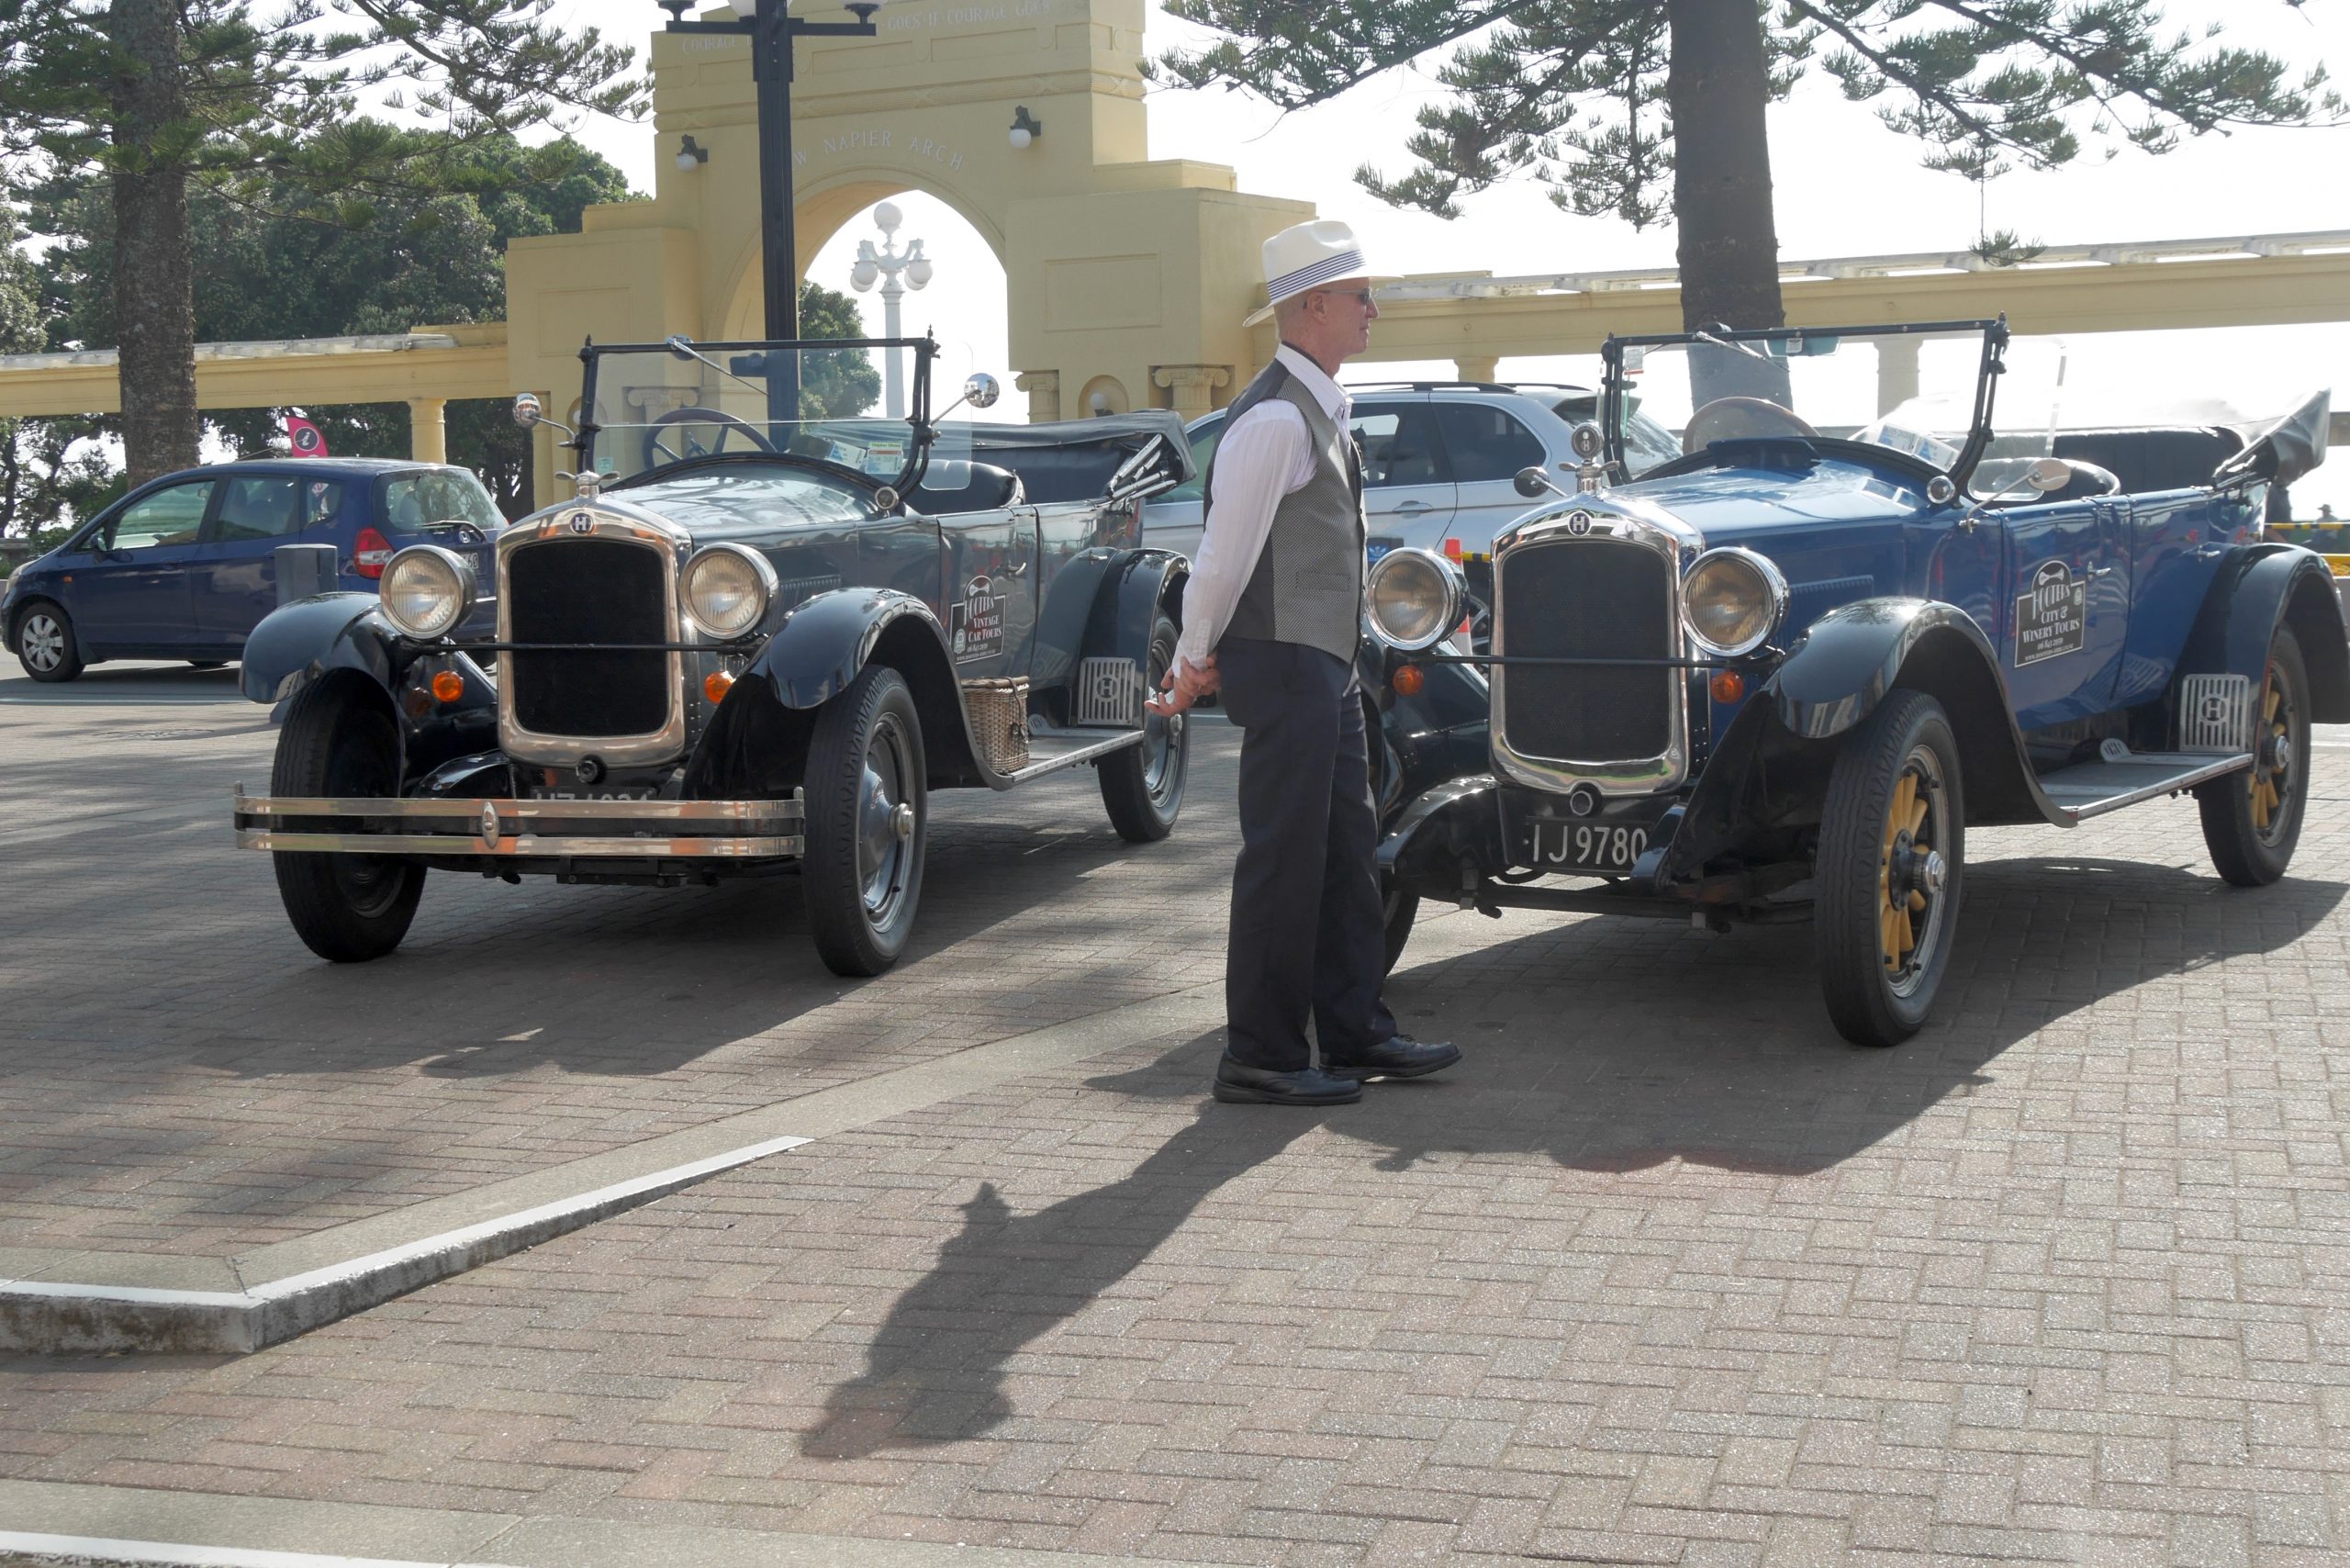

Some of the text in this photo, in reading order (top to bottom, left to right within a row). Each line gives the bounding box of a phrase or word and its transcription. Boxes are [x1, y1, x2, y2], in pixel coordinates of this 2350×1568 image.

[947, 6, 1008, 24] COURAGE
[822, 129, 964, 173] NAPIER ARCH
[575, 516, 587, 531] H
[1572, 516, 1585, 532] H
[964, 597, 994, 625] HOOTERS
[2032, 584, 2071, 620] HOOTERS
[974, 614, 1000, 629] VINTAGE
[2041, 605, 2068, 624] CITY &
[968, 631, 981, 643] CAR
[981, 626, 1002, 640] TOURS
[2022, 625, 2053, 643] WINERY
[2054, 618, 2080, 635] TOURS
